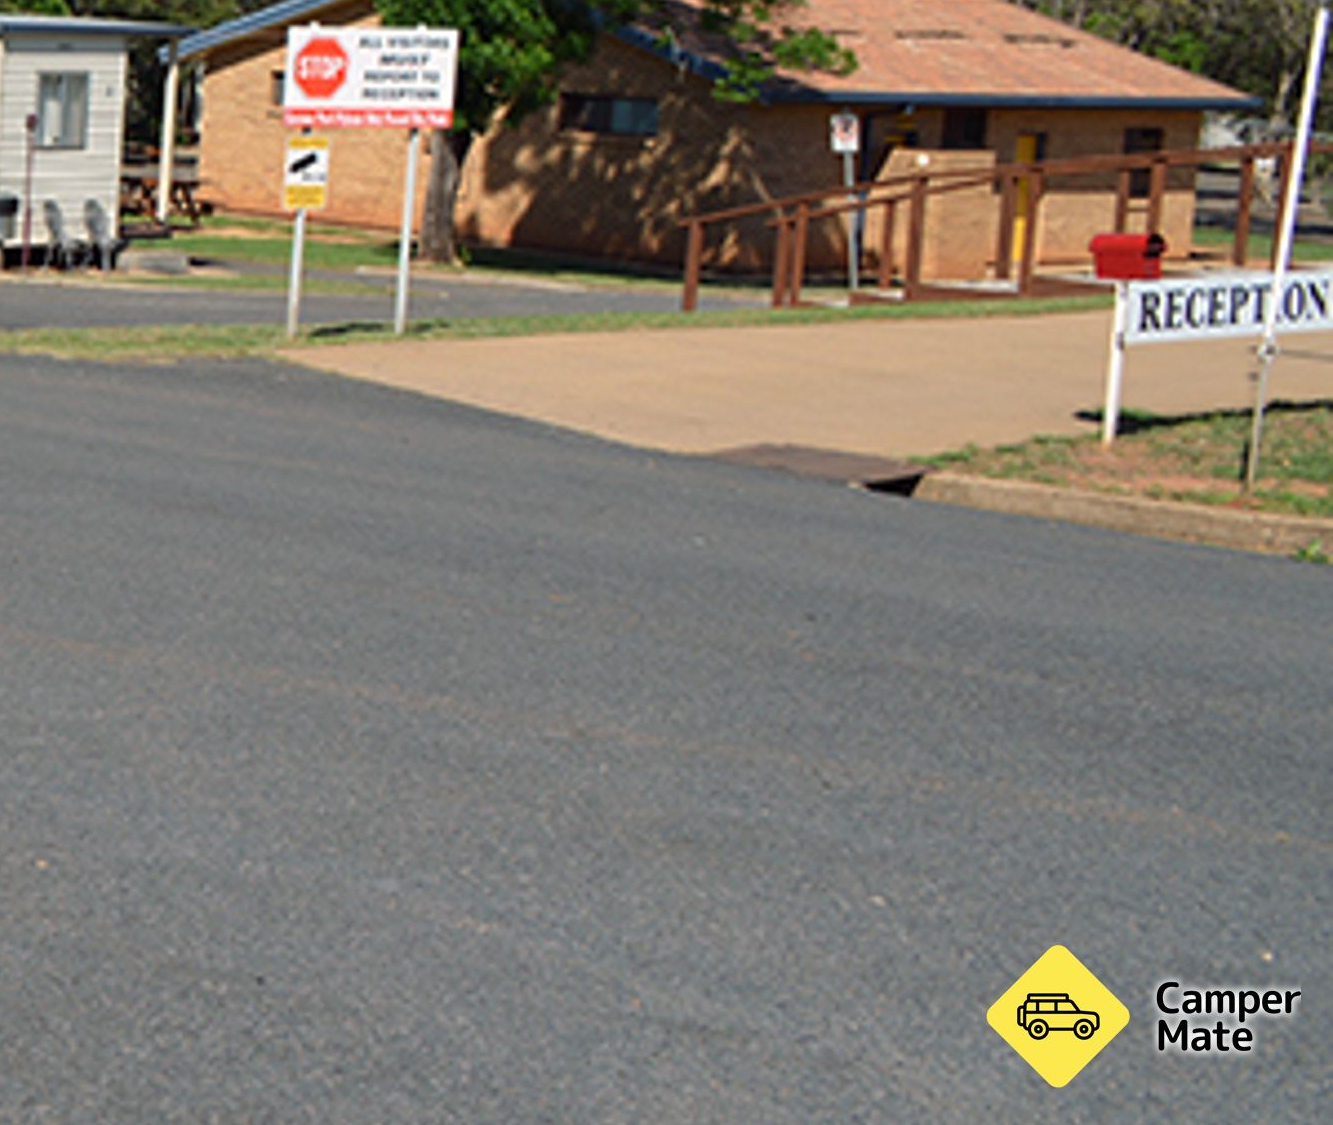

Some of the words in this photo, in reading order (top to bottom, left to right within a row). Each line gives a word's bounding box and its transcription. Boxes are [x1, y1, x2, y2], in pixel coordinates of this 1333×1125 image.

[359, 37, 382, 49] ALL
[387, 37, 450, 49] VISITORS
[380, 54, 432, 65] MUST
[299, 55, 345, 81] STOP
[364, 71, 418, 82] REPORT
[363, 87, 440, 99] RECEPTION
[1139, 279, 1329, 332] RECEPTON
